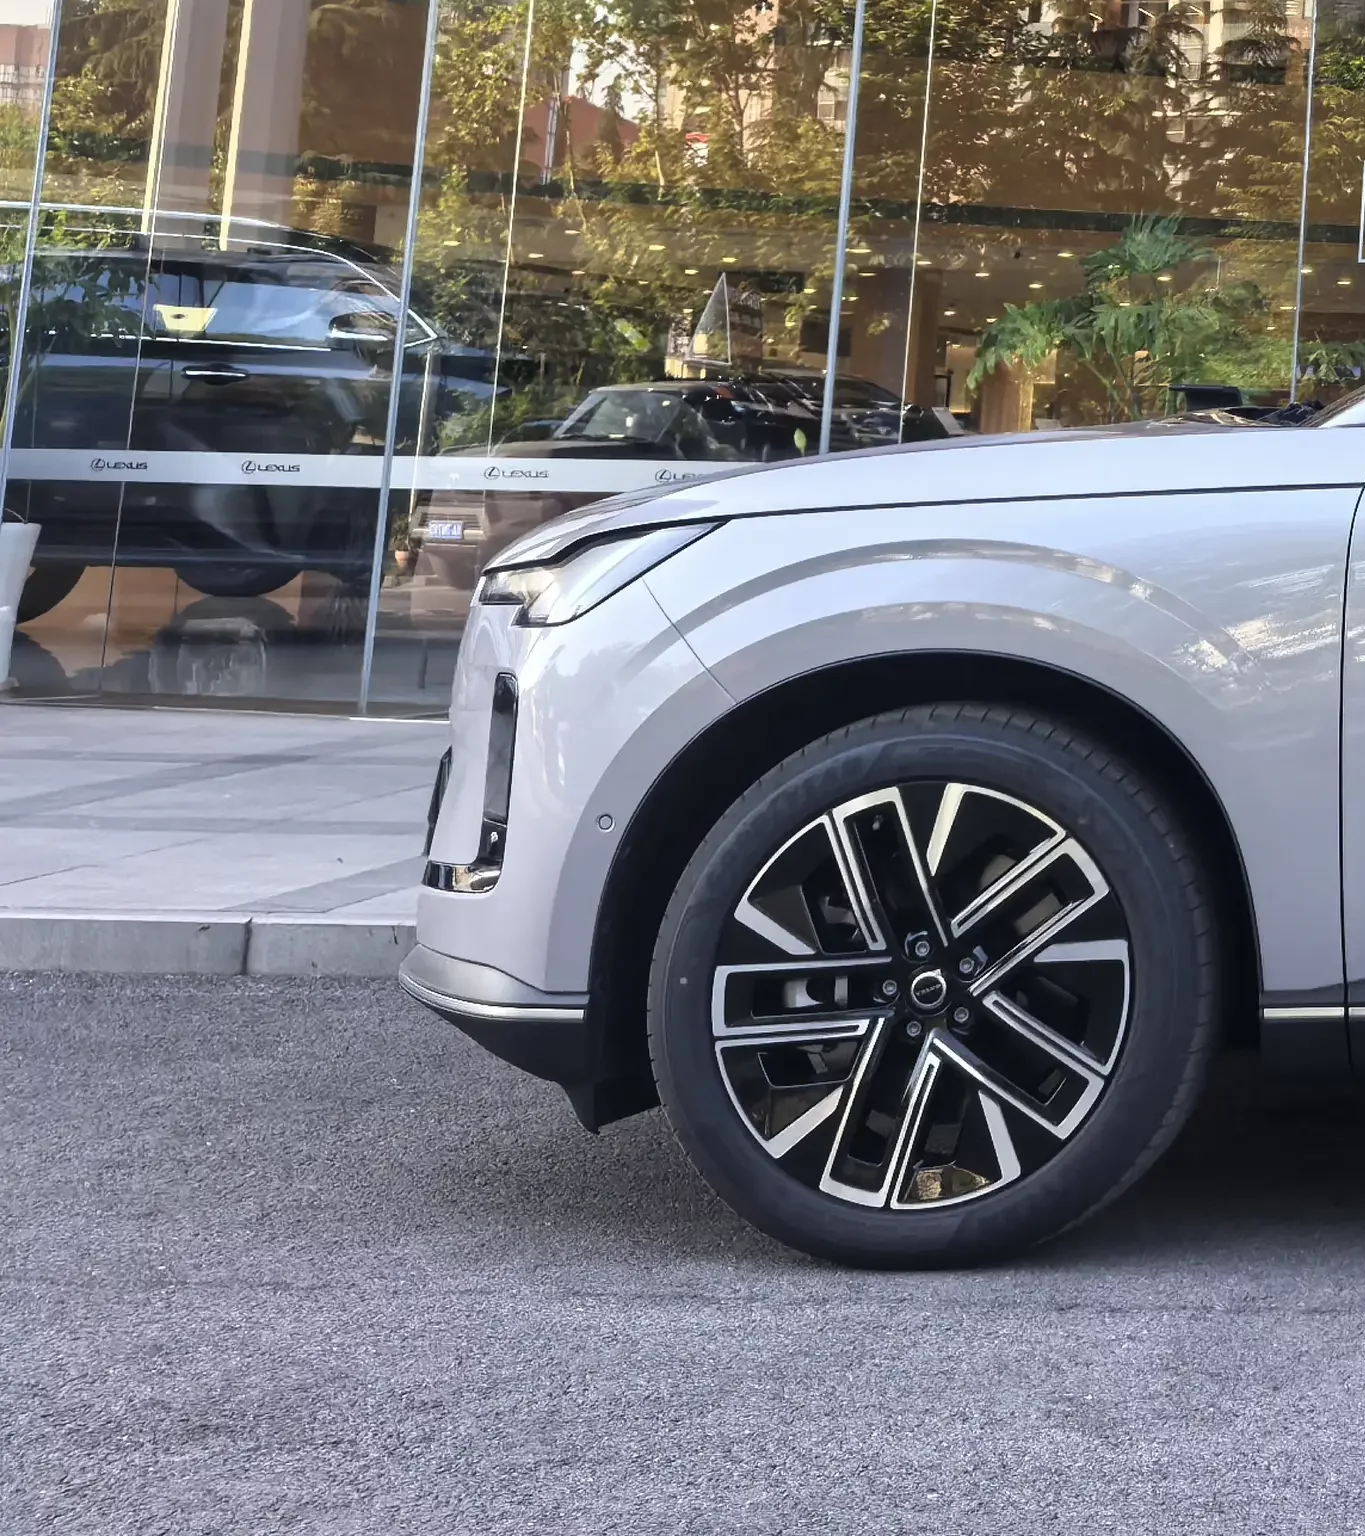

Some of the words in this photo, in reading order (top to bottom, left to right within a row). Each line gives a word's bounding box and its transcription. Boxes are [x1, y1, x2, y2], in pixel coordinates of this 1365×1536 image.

[106, 461, 148, 470] LEXUS
[257, 463, 301, 473] LEXUS
[502, 470, 550, 479] LEXUS
